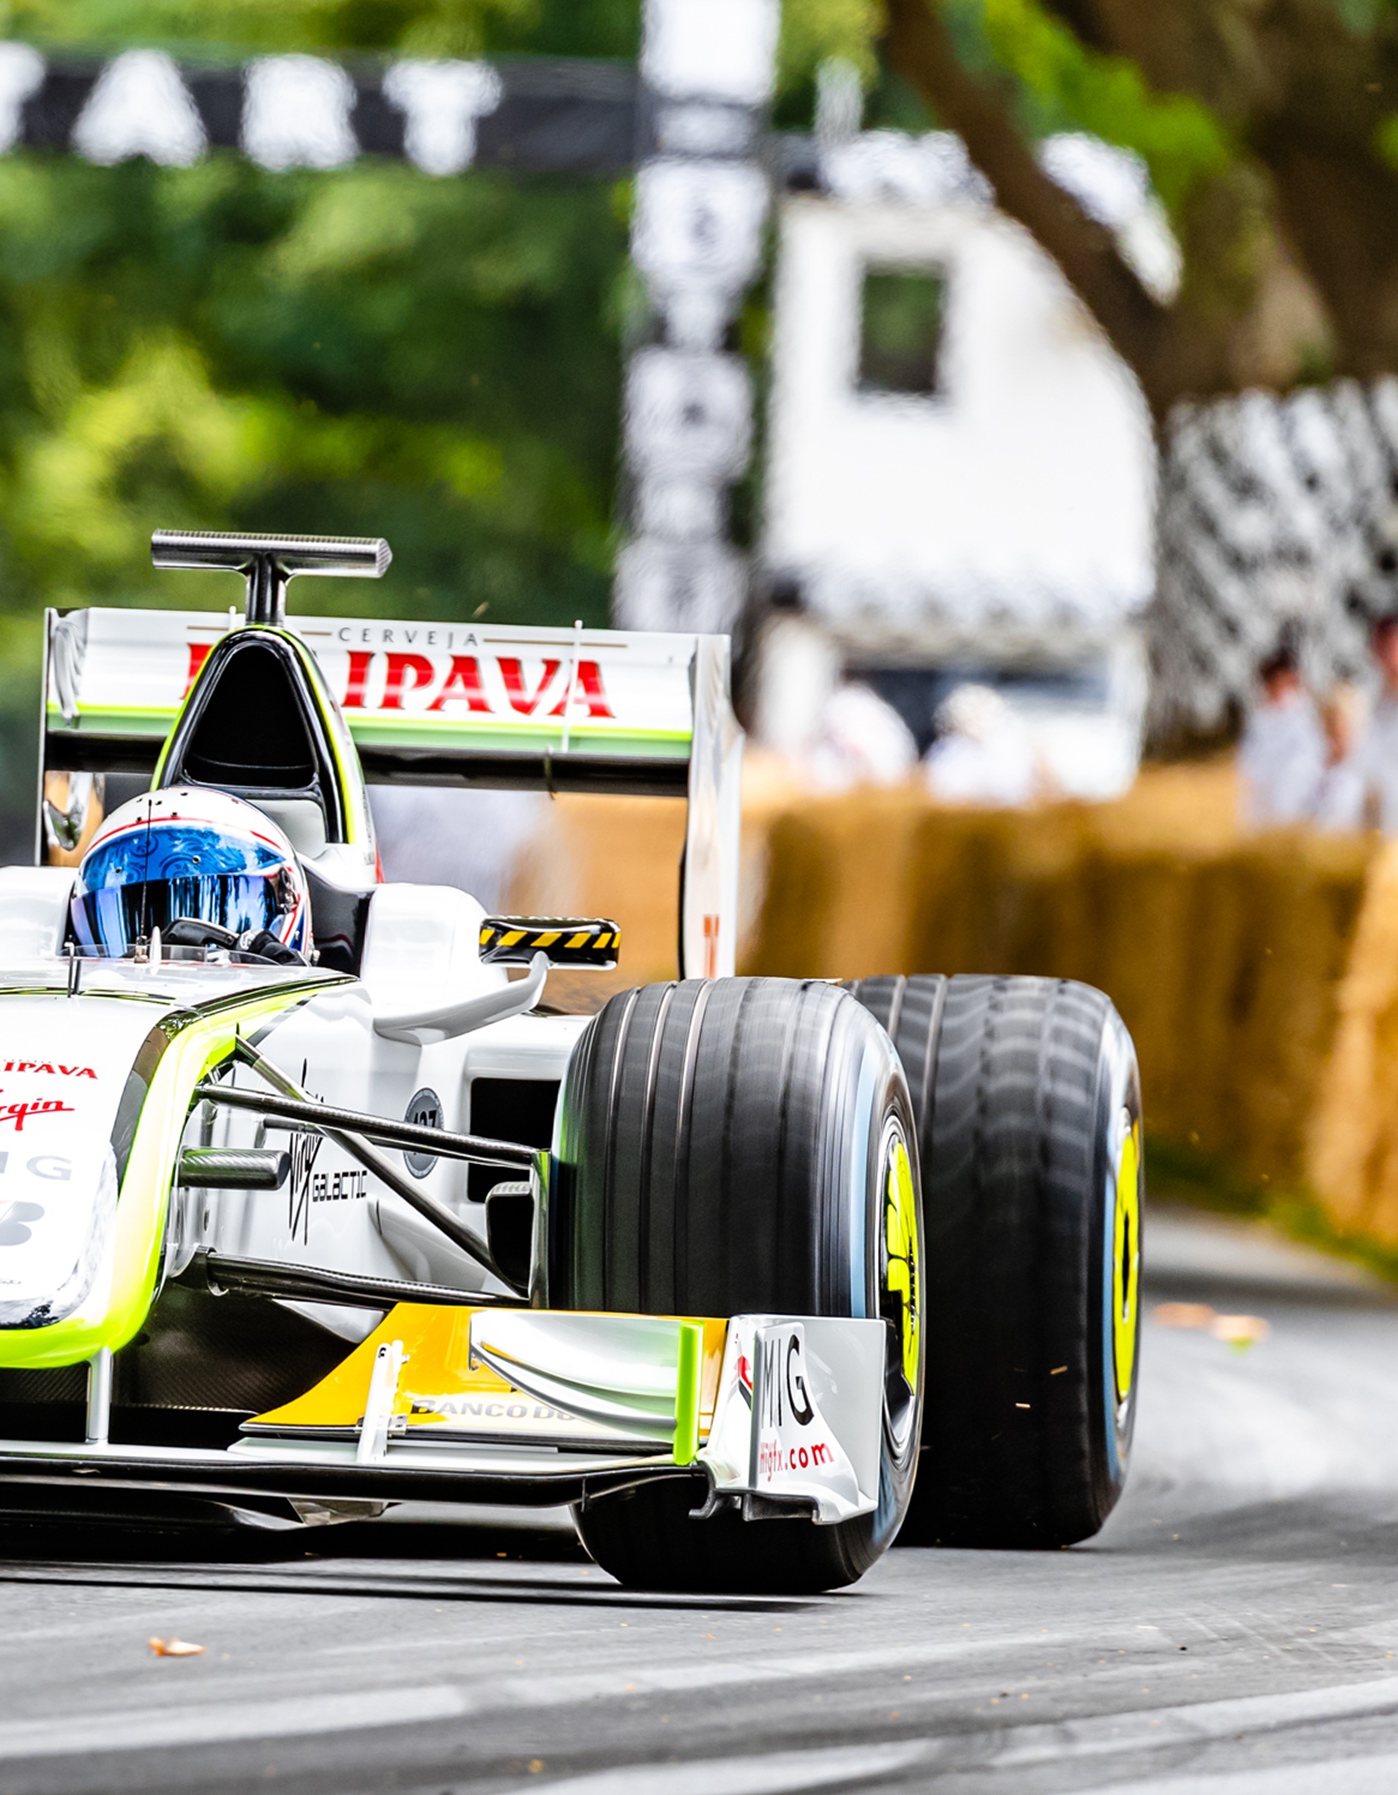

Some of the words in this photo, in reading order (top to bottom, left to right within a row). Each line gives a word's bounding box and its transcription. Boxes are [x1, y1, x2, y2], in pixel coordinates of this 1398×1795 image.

[338, 626, 479, 648] CERVEJA
[180, 642, 617, 719] IIPAVA
[761, 1333, 815, 1427] MIG
[410, 1399, 529, 1419] BANCO
